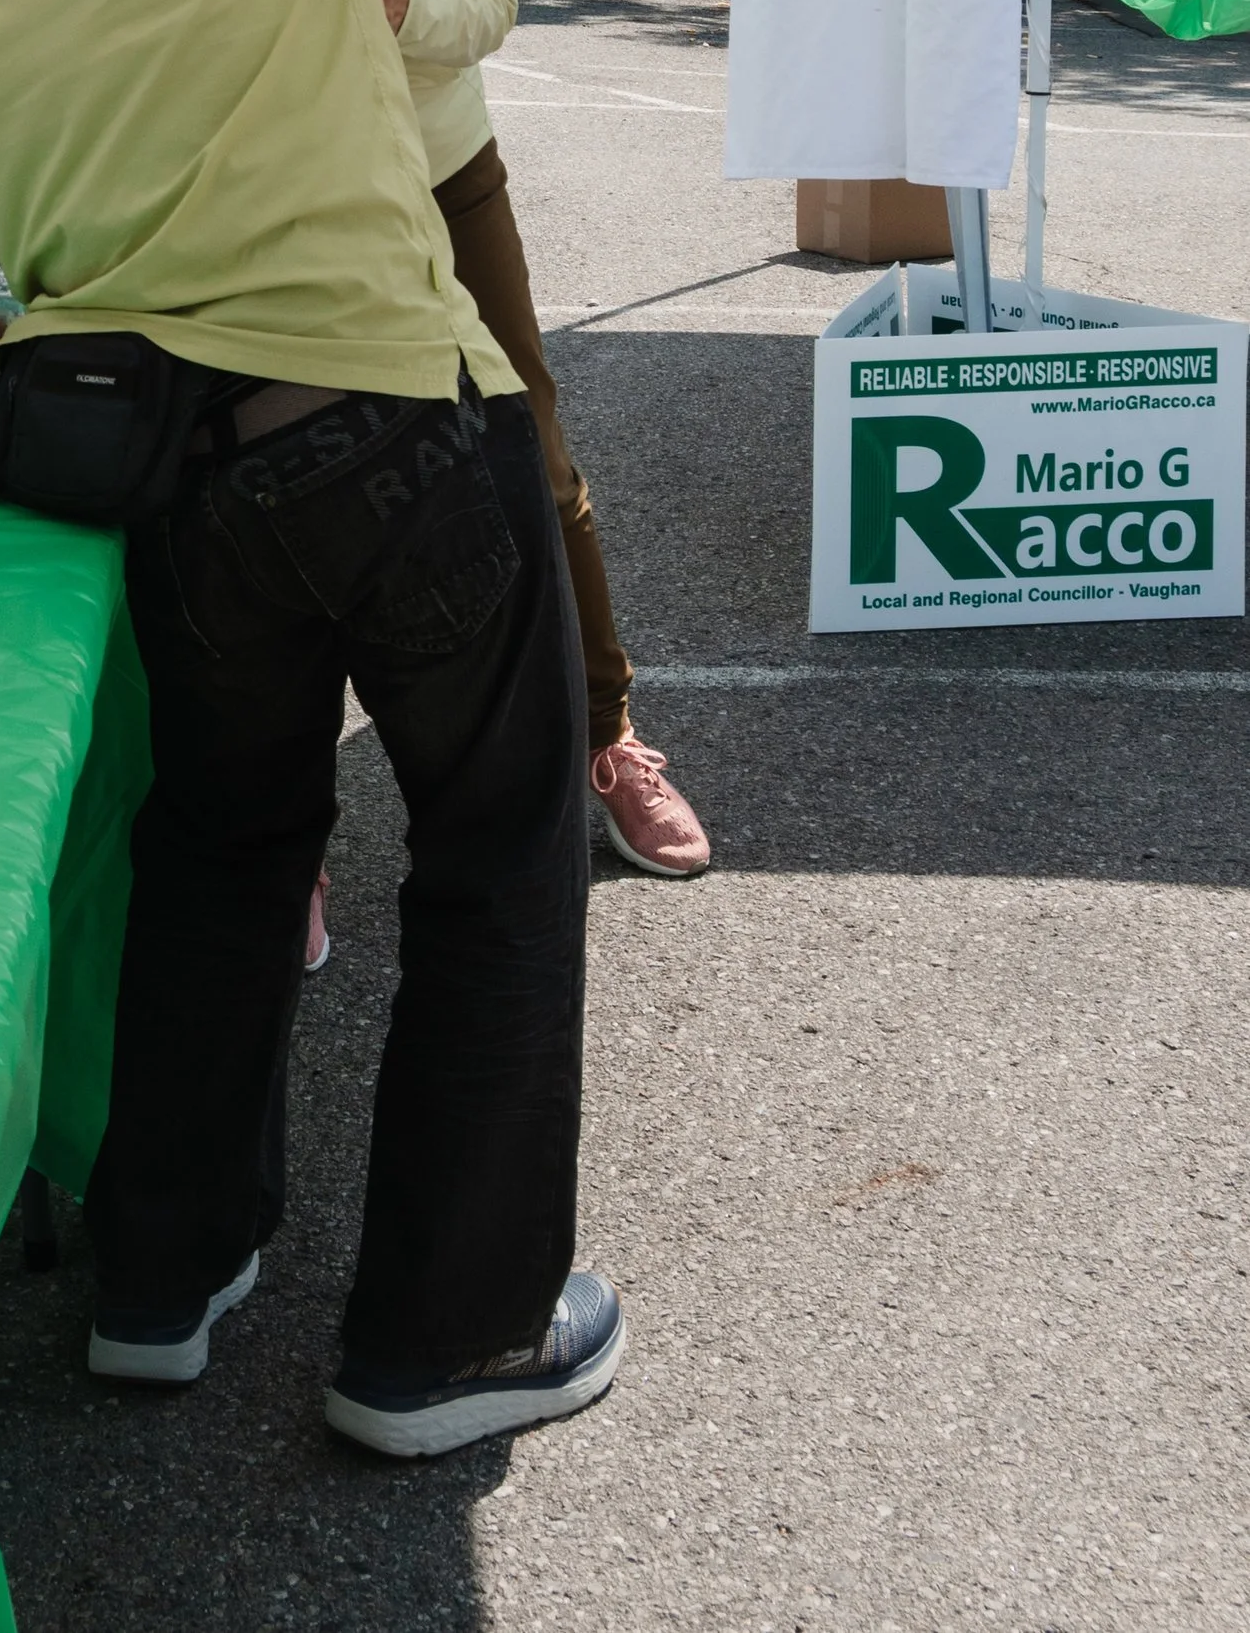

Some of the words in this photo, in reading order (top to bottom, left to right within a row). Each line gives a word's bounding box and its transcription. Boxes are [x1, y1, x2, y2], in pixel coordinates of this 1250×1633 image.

[859, 366, 949, 391] RELIABLE
[958, 360, 1087, 388] RESPONSIBLE
[1097, 355, 1212, 382] RESPONSIVE
[1031, 394, 1216, 414] www.MarioGRacco.ca
[1015, 448, 1144, 494] Mario
[1158, 447, 1190, 487] G
[849, 414, 1197, 585] Racco
[862, 594, 907, 610] Local
[912, 592, 944, 608] and
[949, 588, 1023, 608] Regional
[1028, 585, 1114, 603] Councillor
[1129, 582, 1202, 601] Vaughan
